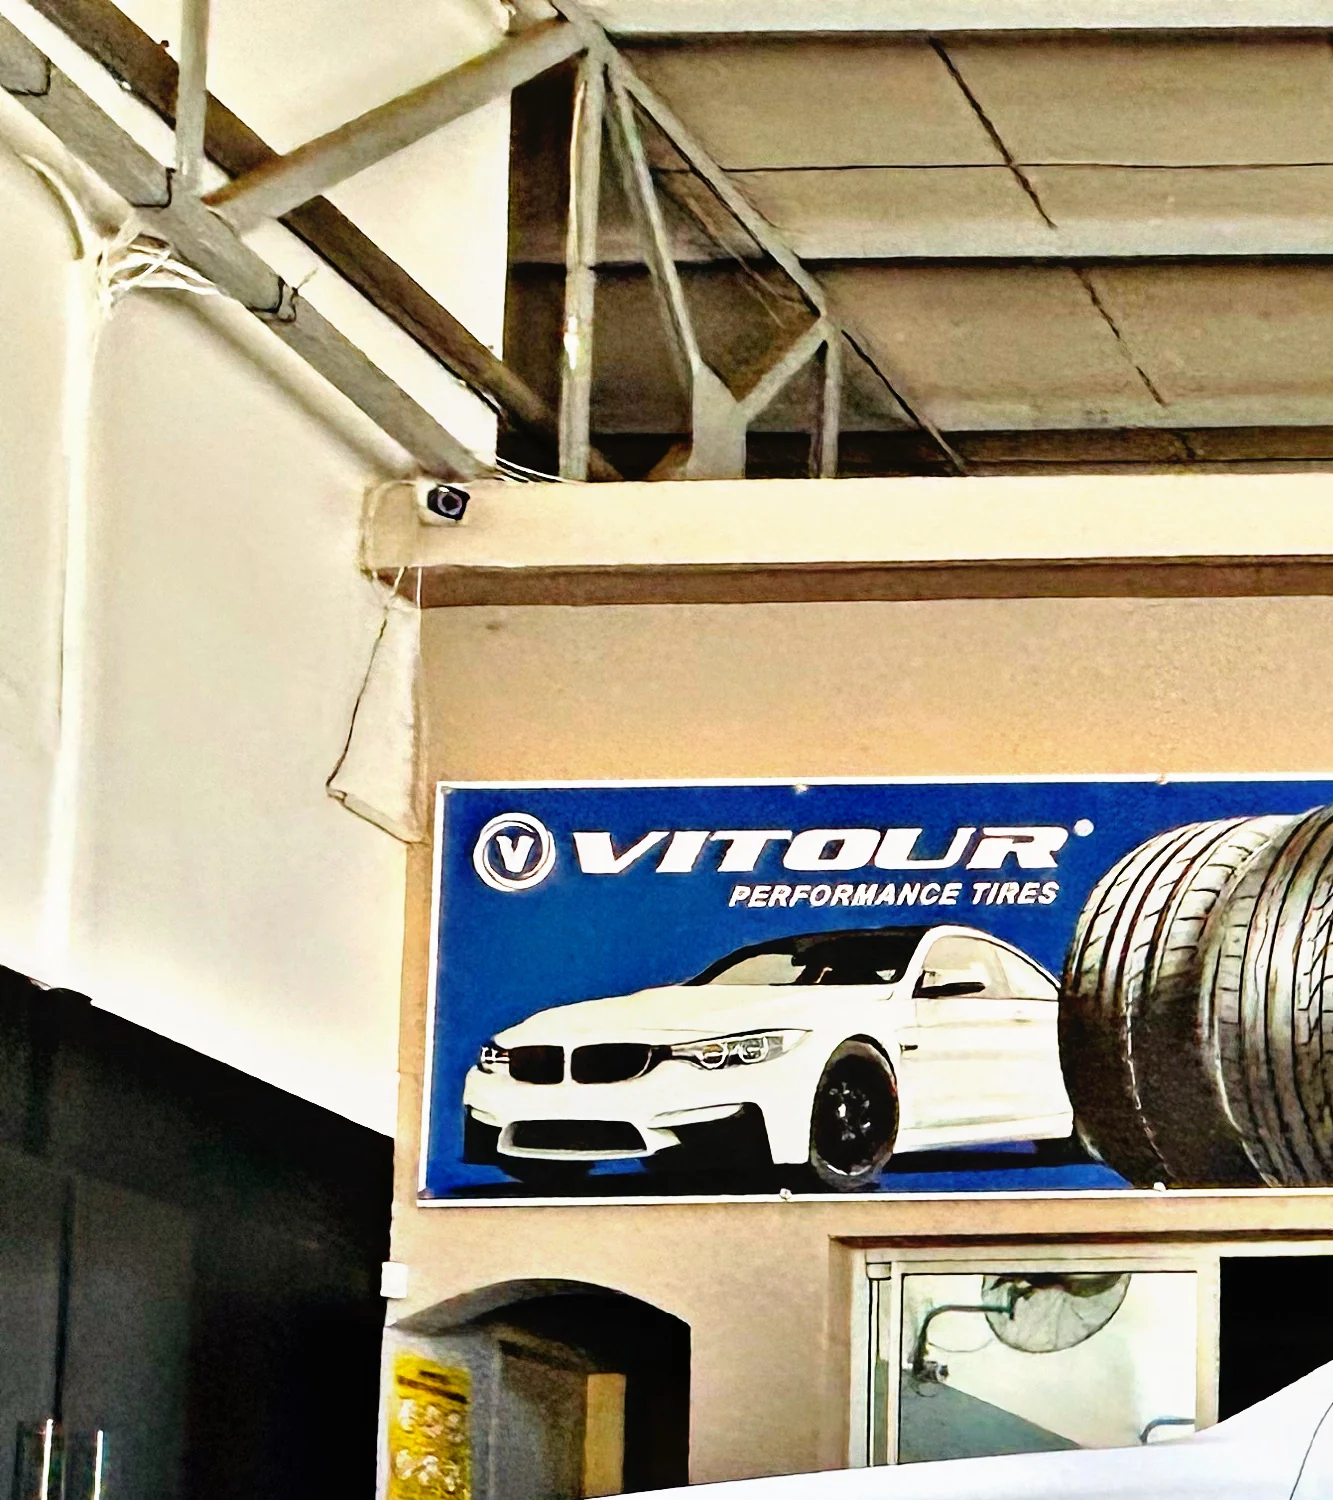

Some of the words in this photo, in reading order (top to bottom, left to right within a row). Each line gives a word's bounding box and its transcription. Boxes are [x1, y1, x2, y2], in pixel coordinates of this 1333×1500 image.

[572, 827, 1070, 874] VITOUR
[728, 883, 960, 909] PERFORMANCE
[971, 881, 1060, 906] TIRES
